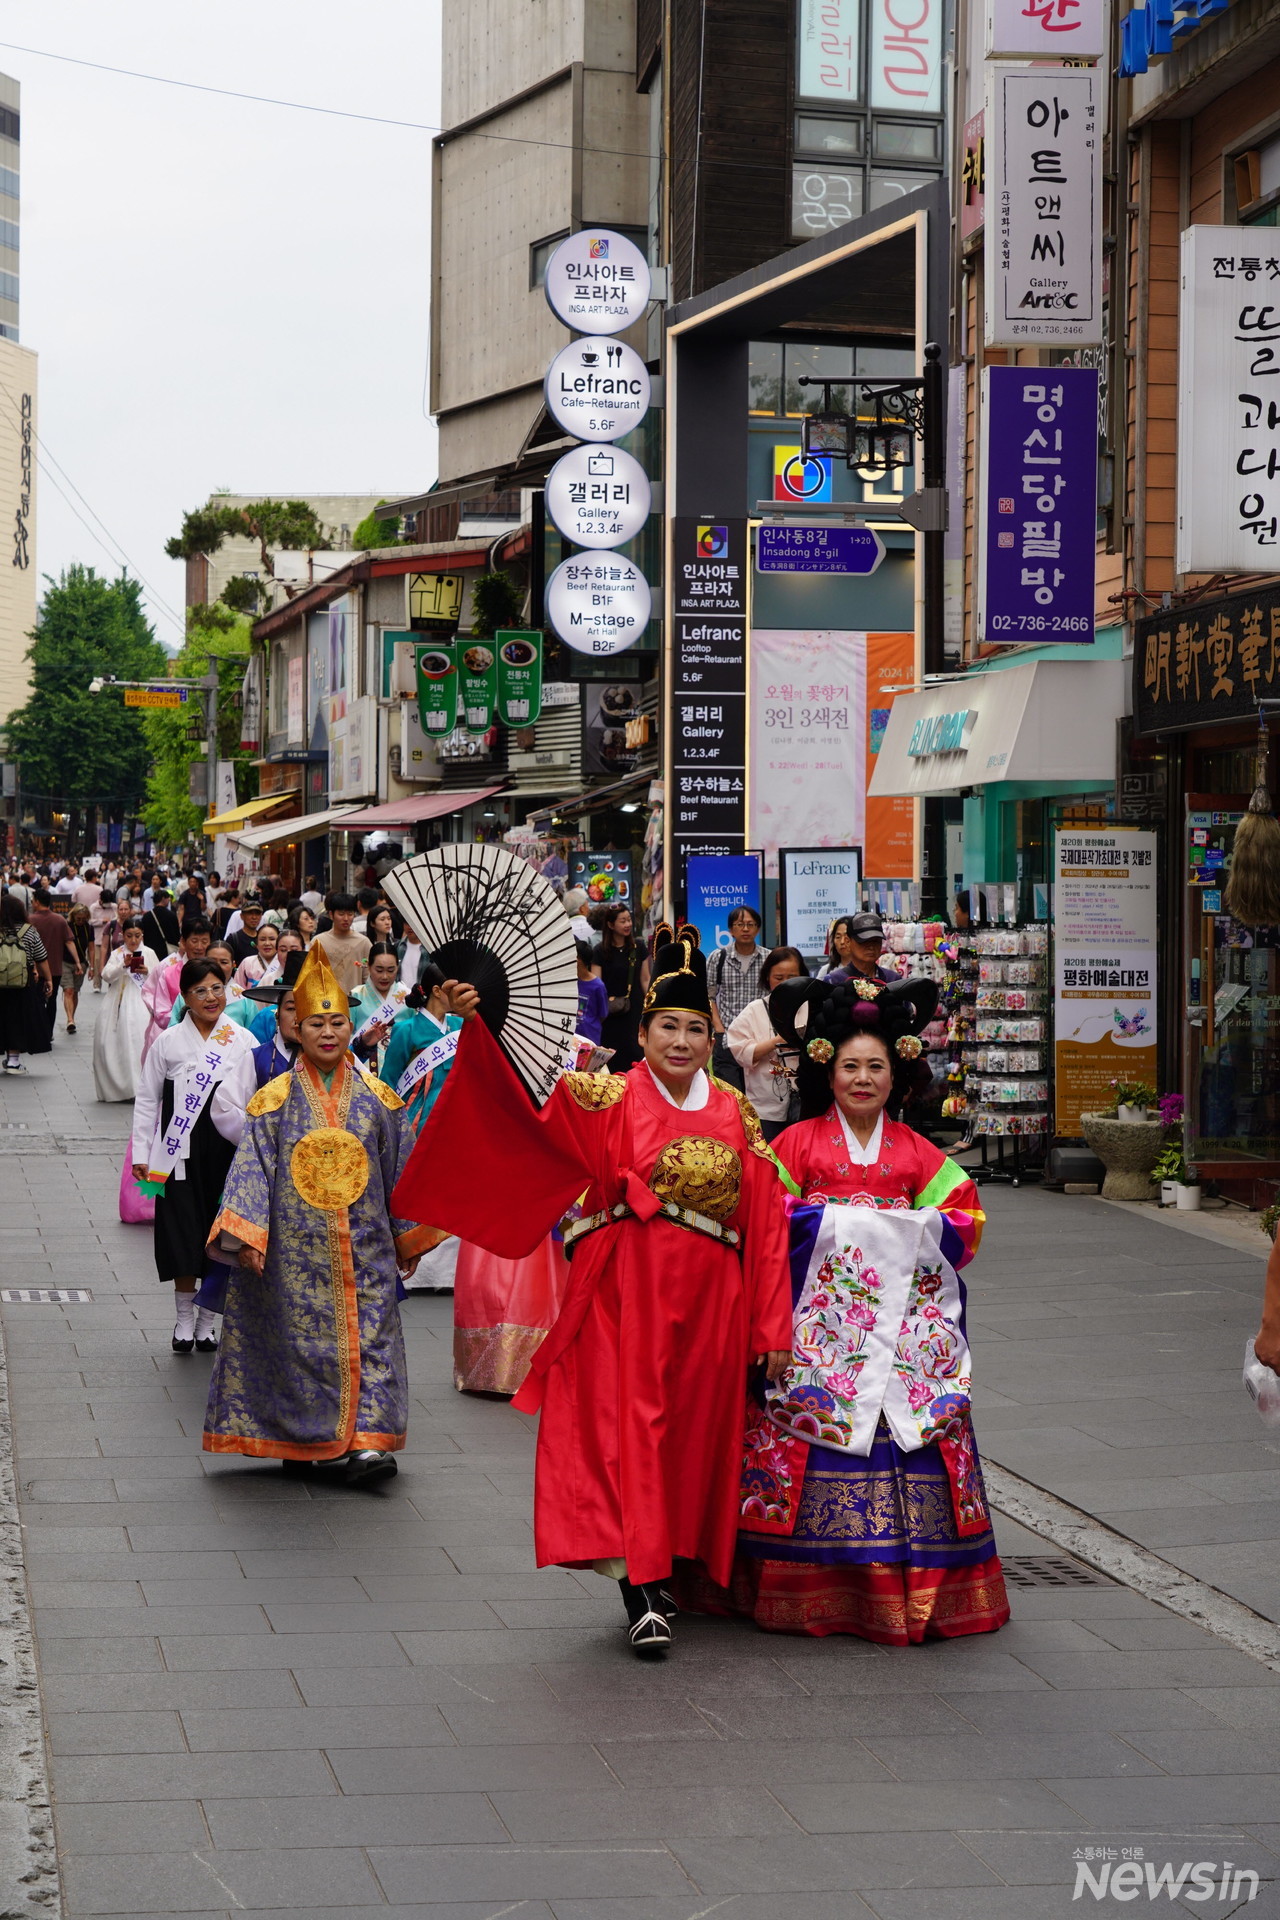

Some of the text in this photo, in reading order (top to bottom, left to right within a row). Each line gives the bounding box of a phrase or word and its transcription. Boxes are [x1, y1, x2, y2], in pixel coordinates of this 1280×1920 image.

[1085, 105, 1095, 149] 갤러리
[1027, 96, 1069, 267] 아트앤씨
[565, 263, 635, 281] 인사아트
[1029, 278, 1068, 289] Gallery
[574, 285, 627, 302] 프라자
[1018, 290, 1079, 309] Art&C
[568, 305, 629, 315] INSA ART PLAZA
[1031, 325, 1083, 335] 02.736.2466
[561, 372, 642, 395] Lefranc
[561, 397, 640, 409] Cafe-Retaurant
[589, 419, 615, 431] 5.6F
[568, 482, 630, 504] 갤러리
[1021, 384, 1066, 605] 명신당필방
[577, 507, 619, 519] Gallery
[576, 522, 624, 534] 1.2.3.4F
[763, 529, 828, 545] 인사동8길
[763, 547, 838, 559] Insadong 8-gil
[566, 566, 637, 581] 장수하늘소
[683, 564, 739, 579] 인사아트
[567, 582, 635, 592] Beef Retaurant
[690, 582, 733, 596] 프라자
[592, 594, 613, 606] B1F
[681, 599, 740, 608] INSA ART PLAZA
[570, 612, 635, 628] M-stage
[992, 615, 1089, 631] 02-736-2466
[587, 627, 617, 636] Art Hall
[682, 624, 742, 641] Lefranc
[592, 641, 616, 652] B2F
[681, 654, 742, 664] Cafe-Retaurant
[682, 673, 703, 682] 5.6F
[878, 667, 902, 678] 2024
[429, 684, 444, 693] 커피
[764, 684, 849, 702] 오월의 꽃향기
[147, 695, 163, 704] CCTV
[681, 706, 723, 722] 갤러리
[764, 707, 849, 729] 3인 3색전
[682, 726, 724, 739] Gallery
[682, 748, 720, 758] 1.2.3.4F
[680, 777, 744, 792] 장수하늘소
[680, 795, 739, 804] Beef Retaurant
[680, 811, 698, 821] B1F
[1061, 838, 1115, 847] 제20회 평화예술제
[1061, 849, 1151, 866] 국제대표작가초대전 및 깃발전
[793, 861, 850, 876] LeFranc
[700, 885, 748, 894] WELCOME
[816, 889, 828, 898] 6F
[704, 897, 747, 907] 환영합니다.
[1064, 958, 1120, 967] 제20회 평화예술제
[1064, 969, 1149, 987] 평화예술대전
[166, 1051, 222, 1156] 국악한마당
